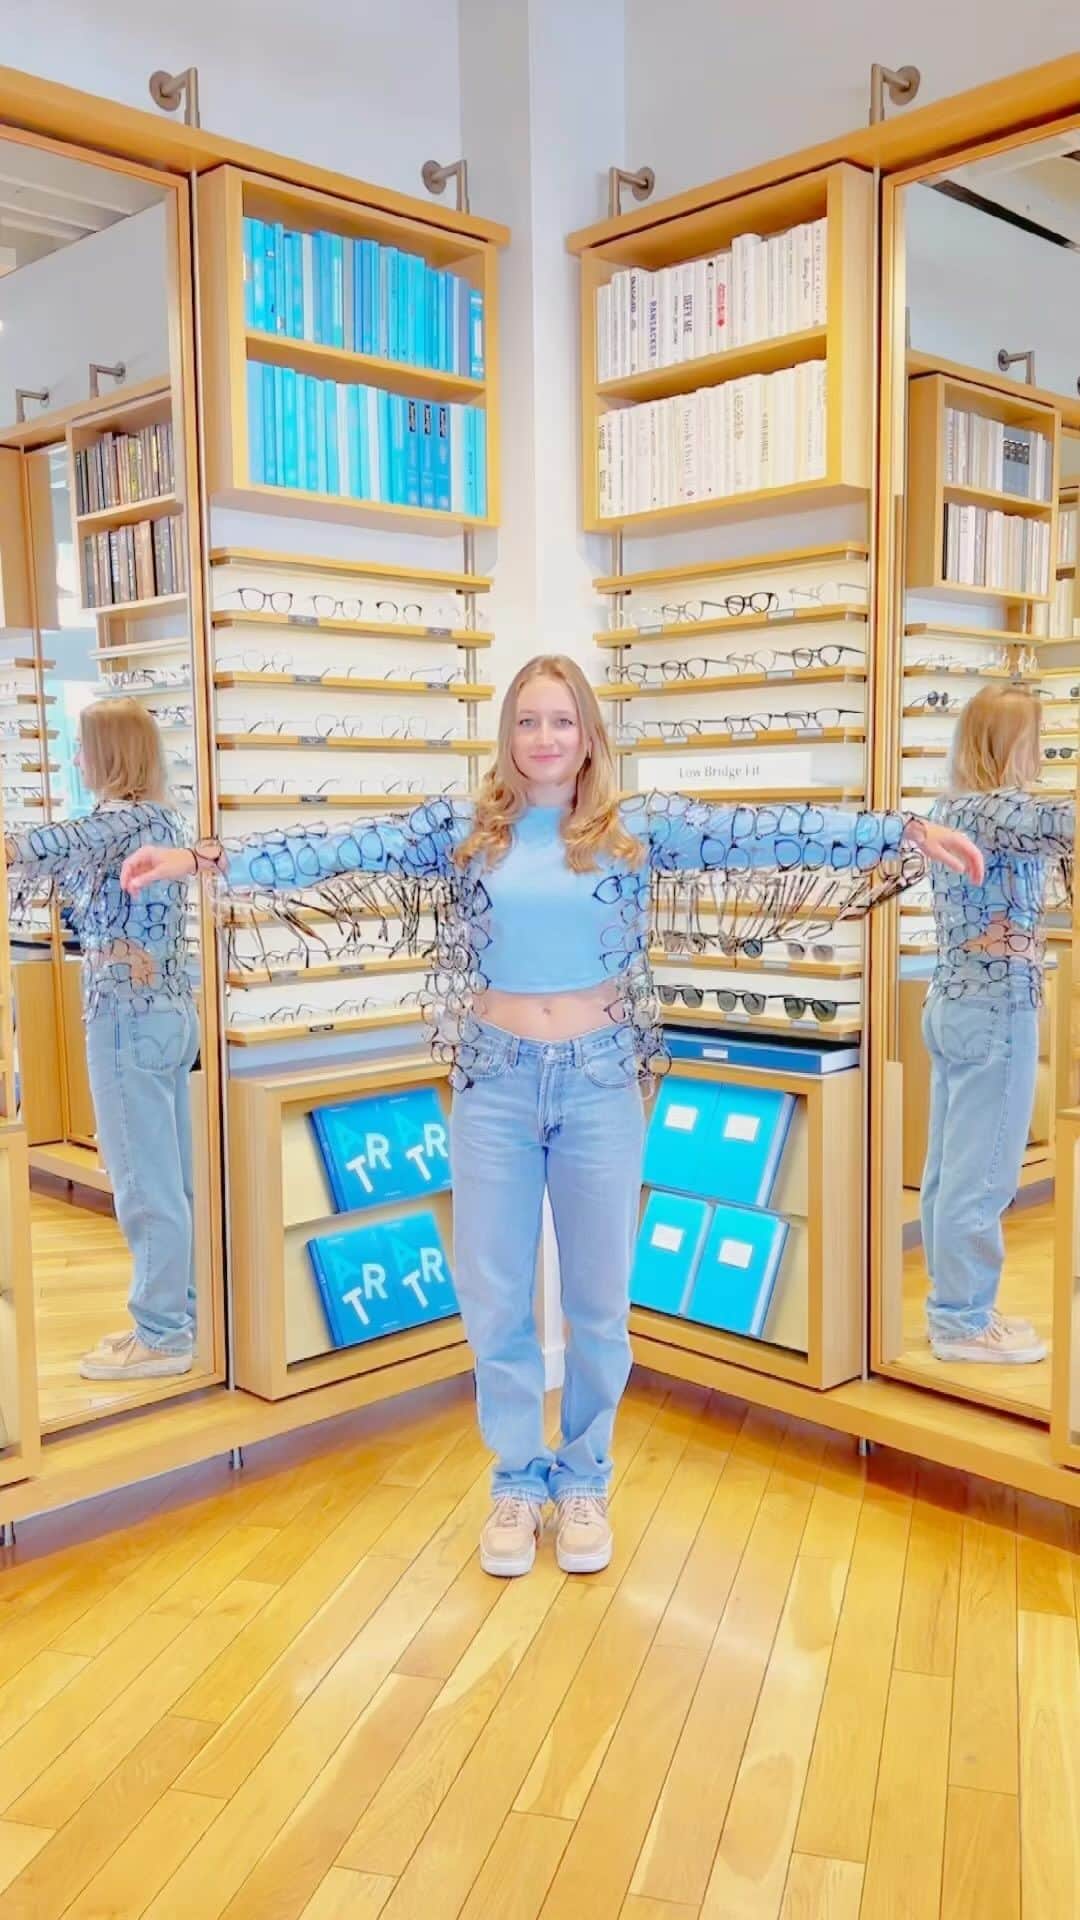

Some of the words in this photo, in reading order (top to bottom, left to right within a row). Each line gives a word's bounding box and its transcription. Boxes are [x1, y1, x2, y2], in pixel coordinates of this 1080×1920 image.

[679, 767, 701, 779] Low
[704, 765, 742, 779] Bridge
[745, 765, 760, 777] Fit
